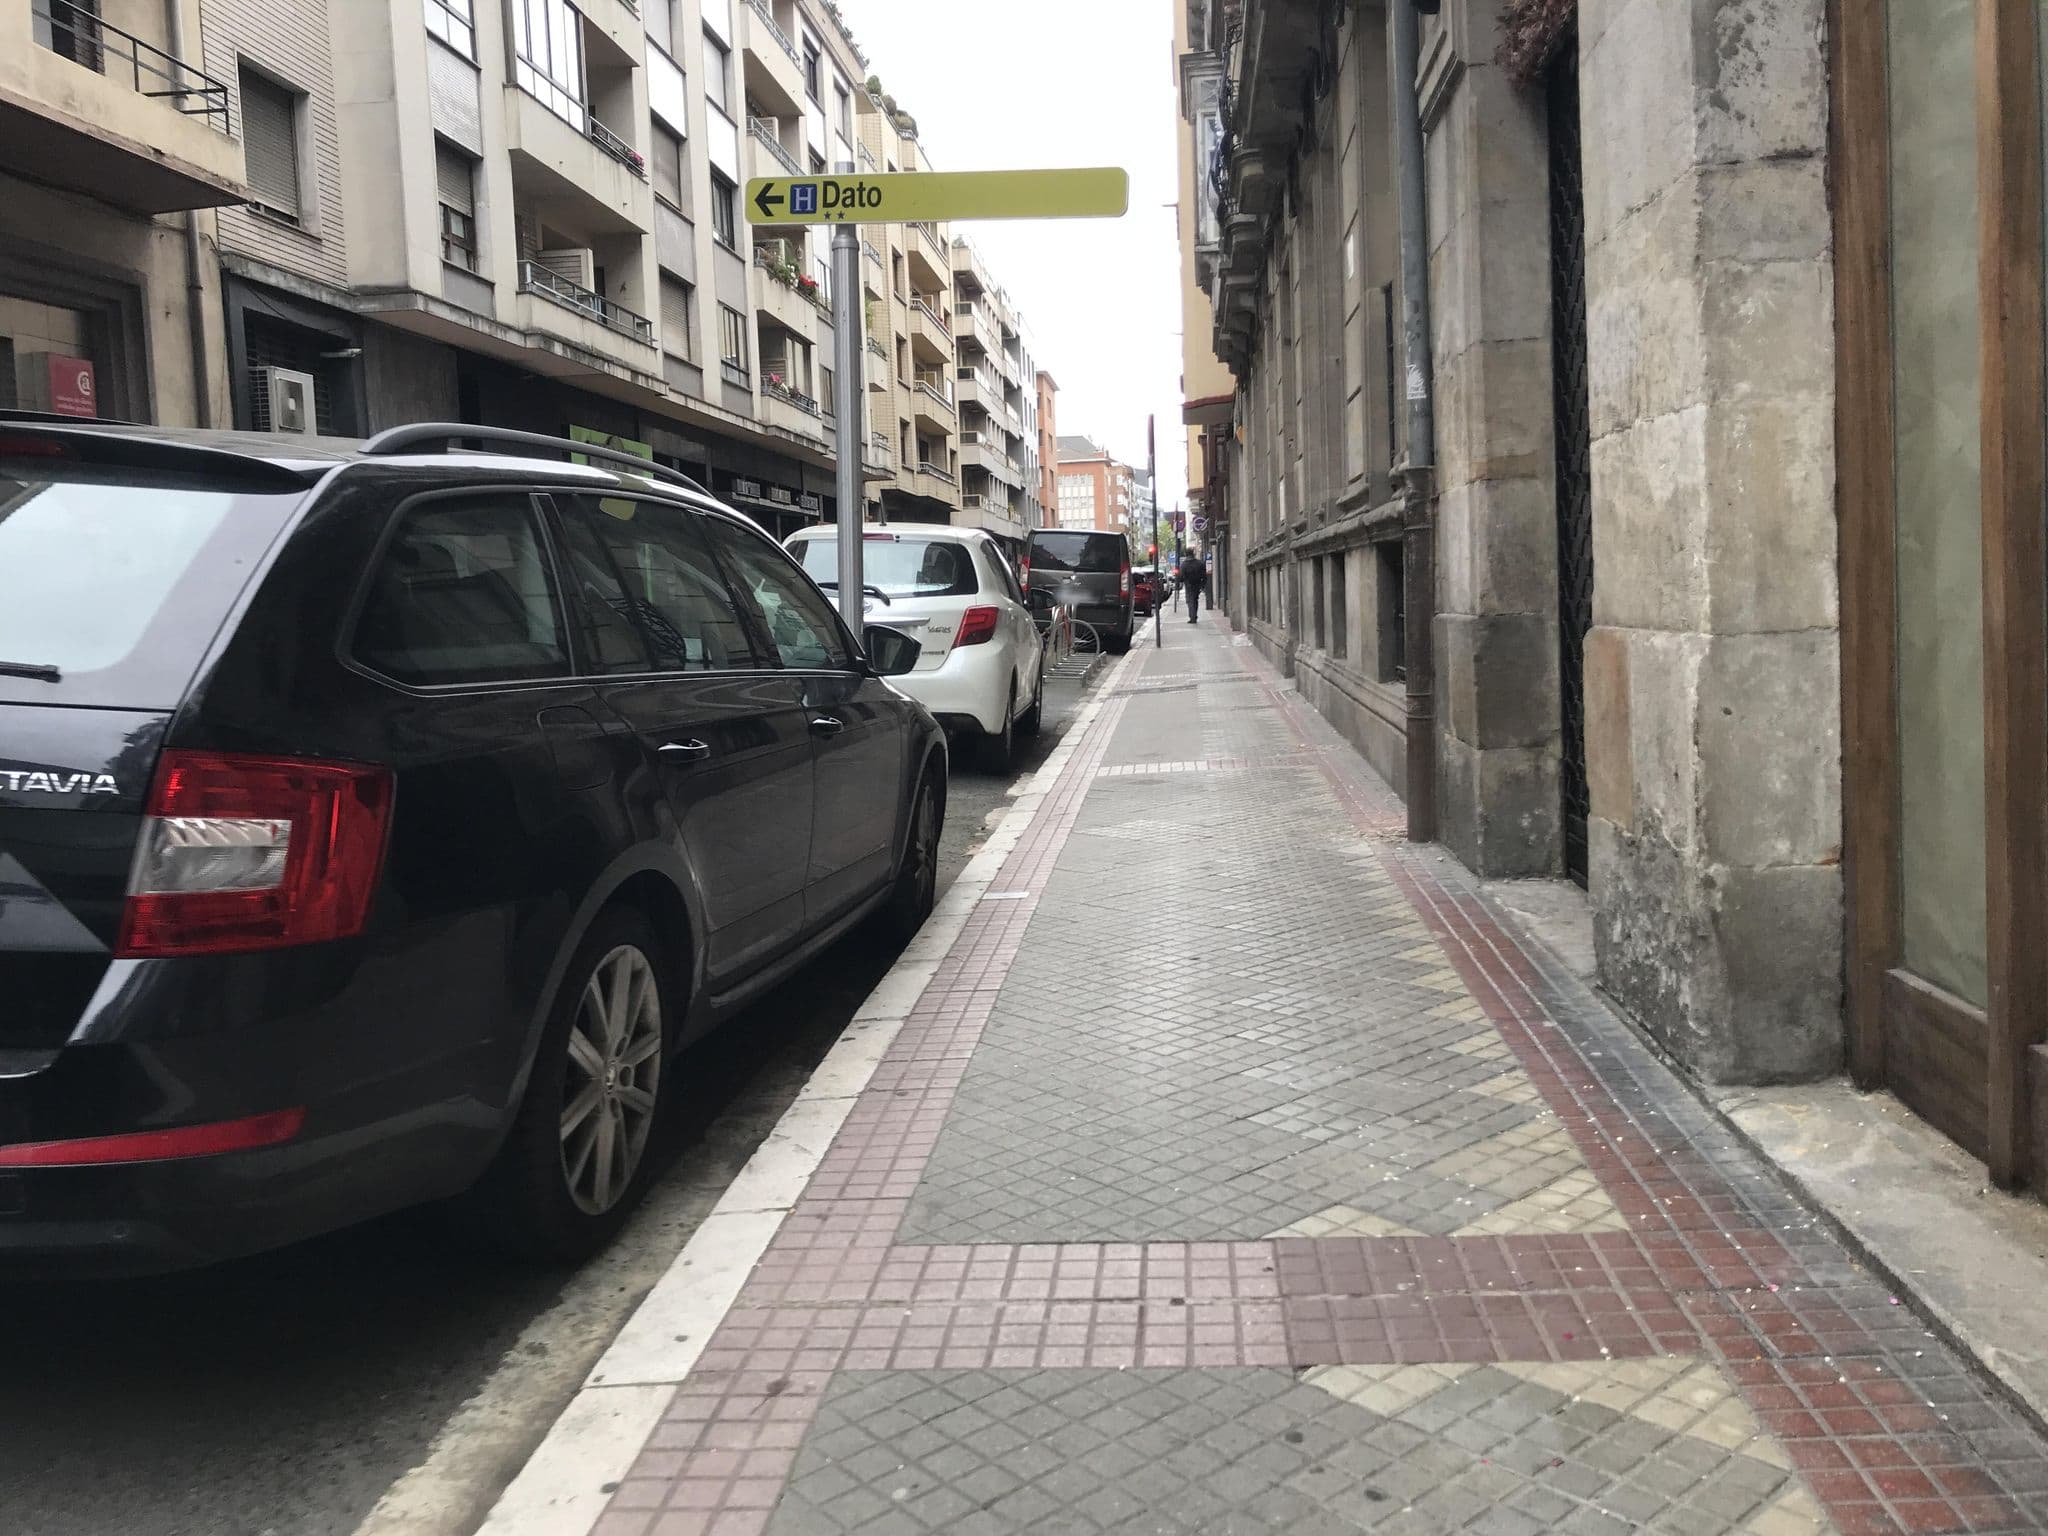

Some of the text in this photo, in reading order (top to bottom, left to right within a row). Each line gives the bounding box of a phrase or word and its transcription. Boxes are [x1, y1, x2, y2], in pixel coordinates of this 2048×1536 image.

[794, 181, 882, 211] H Dato
[0, 770, 120, 795] TAVIA
